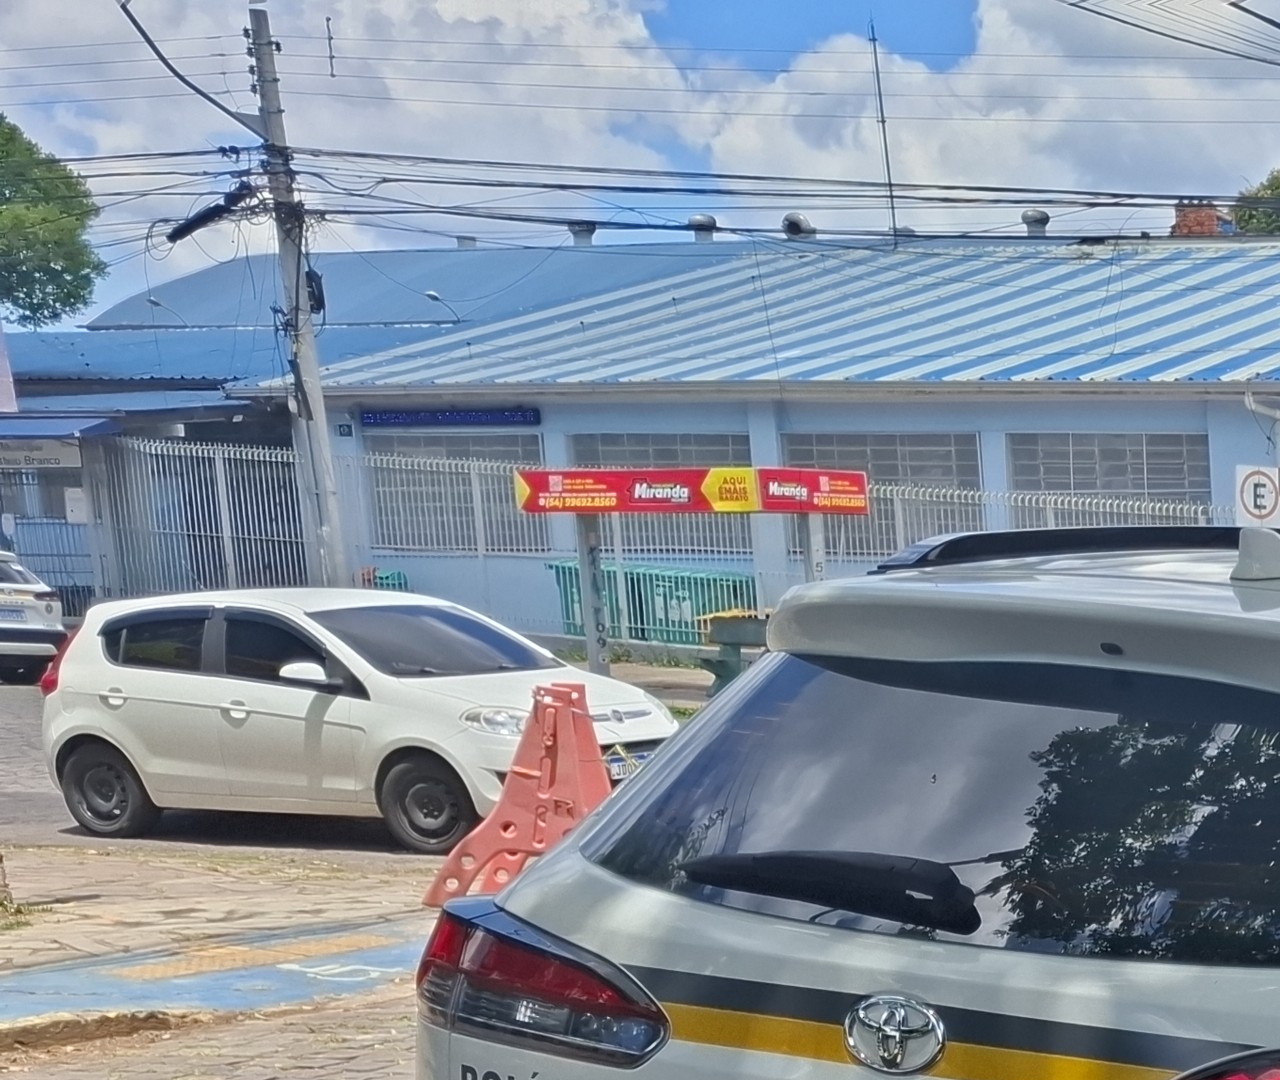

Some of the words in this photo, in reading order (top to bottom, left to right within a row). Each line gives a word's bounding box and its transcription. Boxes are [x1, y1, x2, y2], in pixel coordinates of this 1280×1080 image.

[722, 476, 746, 485] AQUI
[634, 483, 689, 499] Miranda
[769, 481, 807, 497] Miranda
[1253, 483, 1267, 510] E
